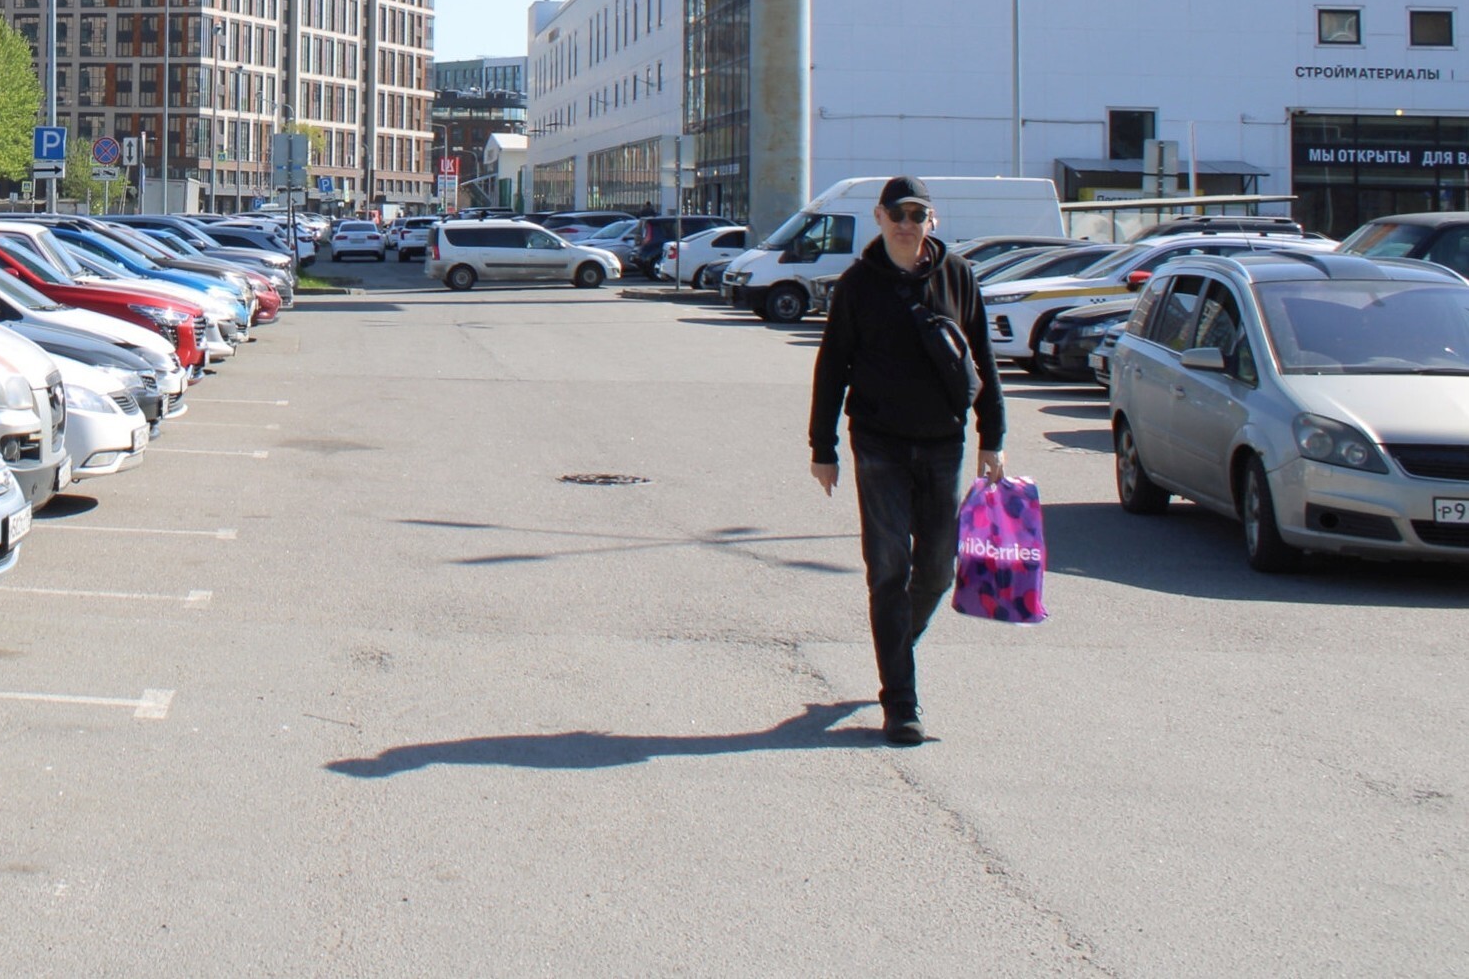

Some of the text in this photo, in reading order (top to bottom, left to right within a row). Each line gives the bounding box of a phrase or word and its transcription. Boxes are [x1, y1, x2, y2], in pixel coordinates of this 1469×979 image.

[1295, 65, 1440, 80] СТРОЙМАТЕРИАЛЫ
[42, 130, 61, 157] P
[1309, 148, 1334, 162] МЫ
[1338, 149, 1410, 163] ОТКРЫТЫ
[1421, 151, 1453, 166] ДЛЯ
[321, 179, 330, 191] P
